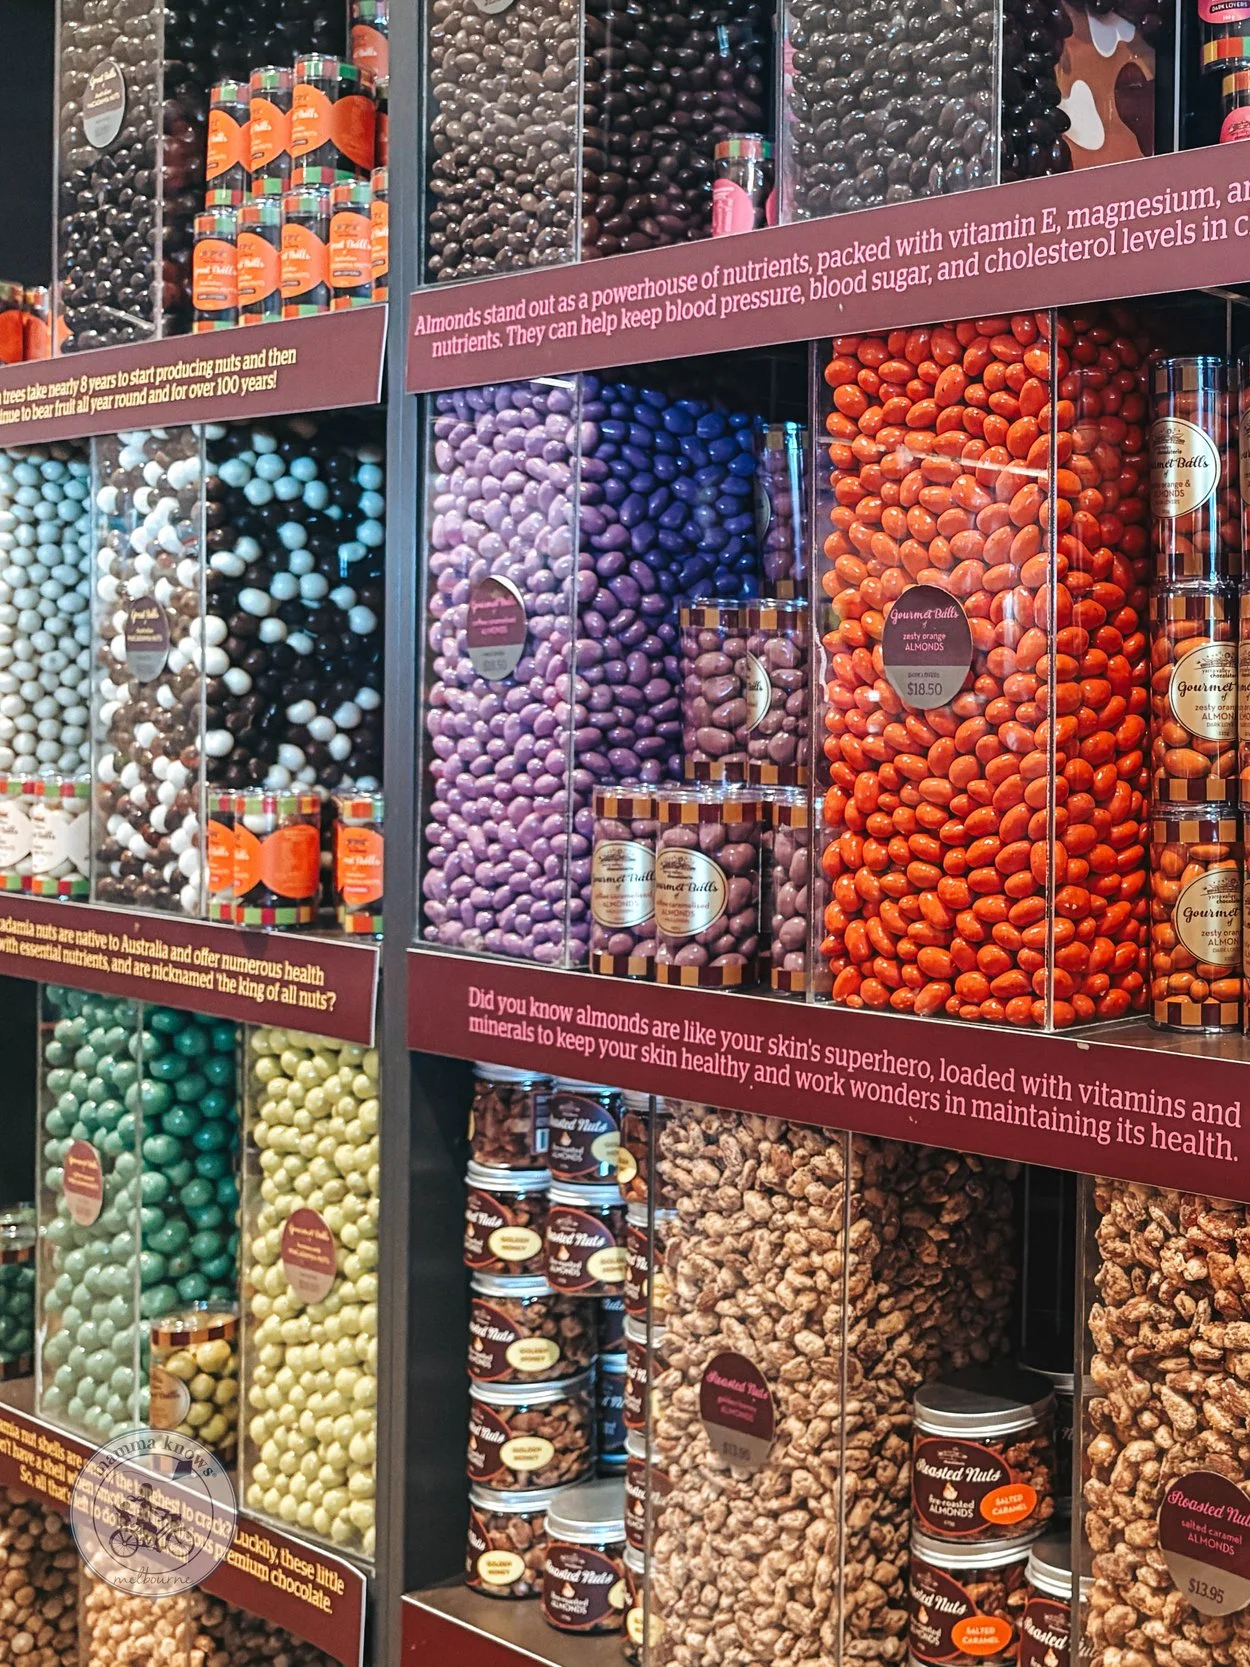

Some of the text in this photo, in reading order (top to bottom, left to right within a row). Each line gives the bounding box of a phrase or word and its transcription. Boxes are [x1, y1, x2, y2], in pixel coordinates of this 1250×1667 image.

[1211, 1, 1248, 12] DARK LOVERS
[414, 307, 482, 336] Almonds
[483, 298, 526, 325] stand
[528, 294, 556, 318] out
[557, 294, 577, 313] as
[578, 292, 589, 310] a
[591, 274, 698, 312] powerhouse
[701, 265, 720, 290] of
[722, 252, 813, 286] nutrients,
[816, 235, 891, 276] packed
[895, 227, 943, 257] with
[948, 216, 1036, 249] vitamin
[1040, 207, 1061, 235] E,
[1066, 186, 1221, 230] magnesium,
[431, 330, 503, 358] nutrients.
[506, 324, 546, 347] They
[548, 320, 578, 340] can
[580, 310, 618, 336] help
[620, 307, 663, 330] keep
[665, 293, 717, 323] blood
[719, 284, 806, 319] pressure,
[809, 269, 867, 301] blood
[871, 264, 933, 293] sugar,
[937, 251, 980, 281] and
[984, 229, 1117, 274] cholesterol
[1121, 219, 1196, 254] levels
[1201, 215, 1228, 242] in
[2, 347, 297, 403] trees take nearly 8 years to start producing nuts and then
[21, 405, 32, 422] to
[31, 403, 55, 421] bear
[54, 398, 76, 418] fruit
[76, 395, 90, 414] all
[90, 395, 114, 415] year
[113, 386, 148, 409] round
[147, 383, 170, 404] and
[170, 382, 188, 401] for
[188, 381, 216, 399] over
[216, 374, 240, 396] 100
[240, 369, 278, 397] years!
[890, 606, 959, 625] Gourmet Balls
[903, 632, 946, 642] zesty orange
[905, 642, 945, 652] ALMONDS
[907, 682, 943, 697] $18.50
[1177, 680, 1235, 698] Gourmet
[35, 924, 58, 941] nuts
[58, 927, 75, 944] are
[75, 930, 108, 950] native
[108, 934, 120, 951] to
[120, 934, 169, 959] Australia
[170, 944, 192, 963] and
[193, 947, 221, 968] offer
[221, 954, 283, 979] numerous
[283, 960, 325, 986] health
[468, 986, 1242, 1129] Did you know almonds are like your skin's superhero, loaded with vitamins and
[916, 1458, 1003, 1483] Roasted Nuts
[928, 1504, 975, 1519] ALMONDS
[991, 1503, 1028, 1517] CARAMEL
[995, 1493, 1024, 1507] SALTED
[1167, 1490, 1226, 1519] Roasted
[1181, 1520, 1243, 1545] salted caramel
[1188, 1533, 1236, 1556] ALMONDS
[1188, 1578, 1225, 1604] $13.95
